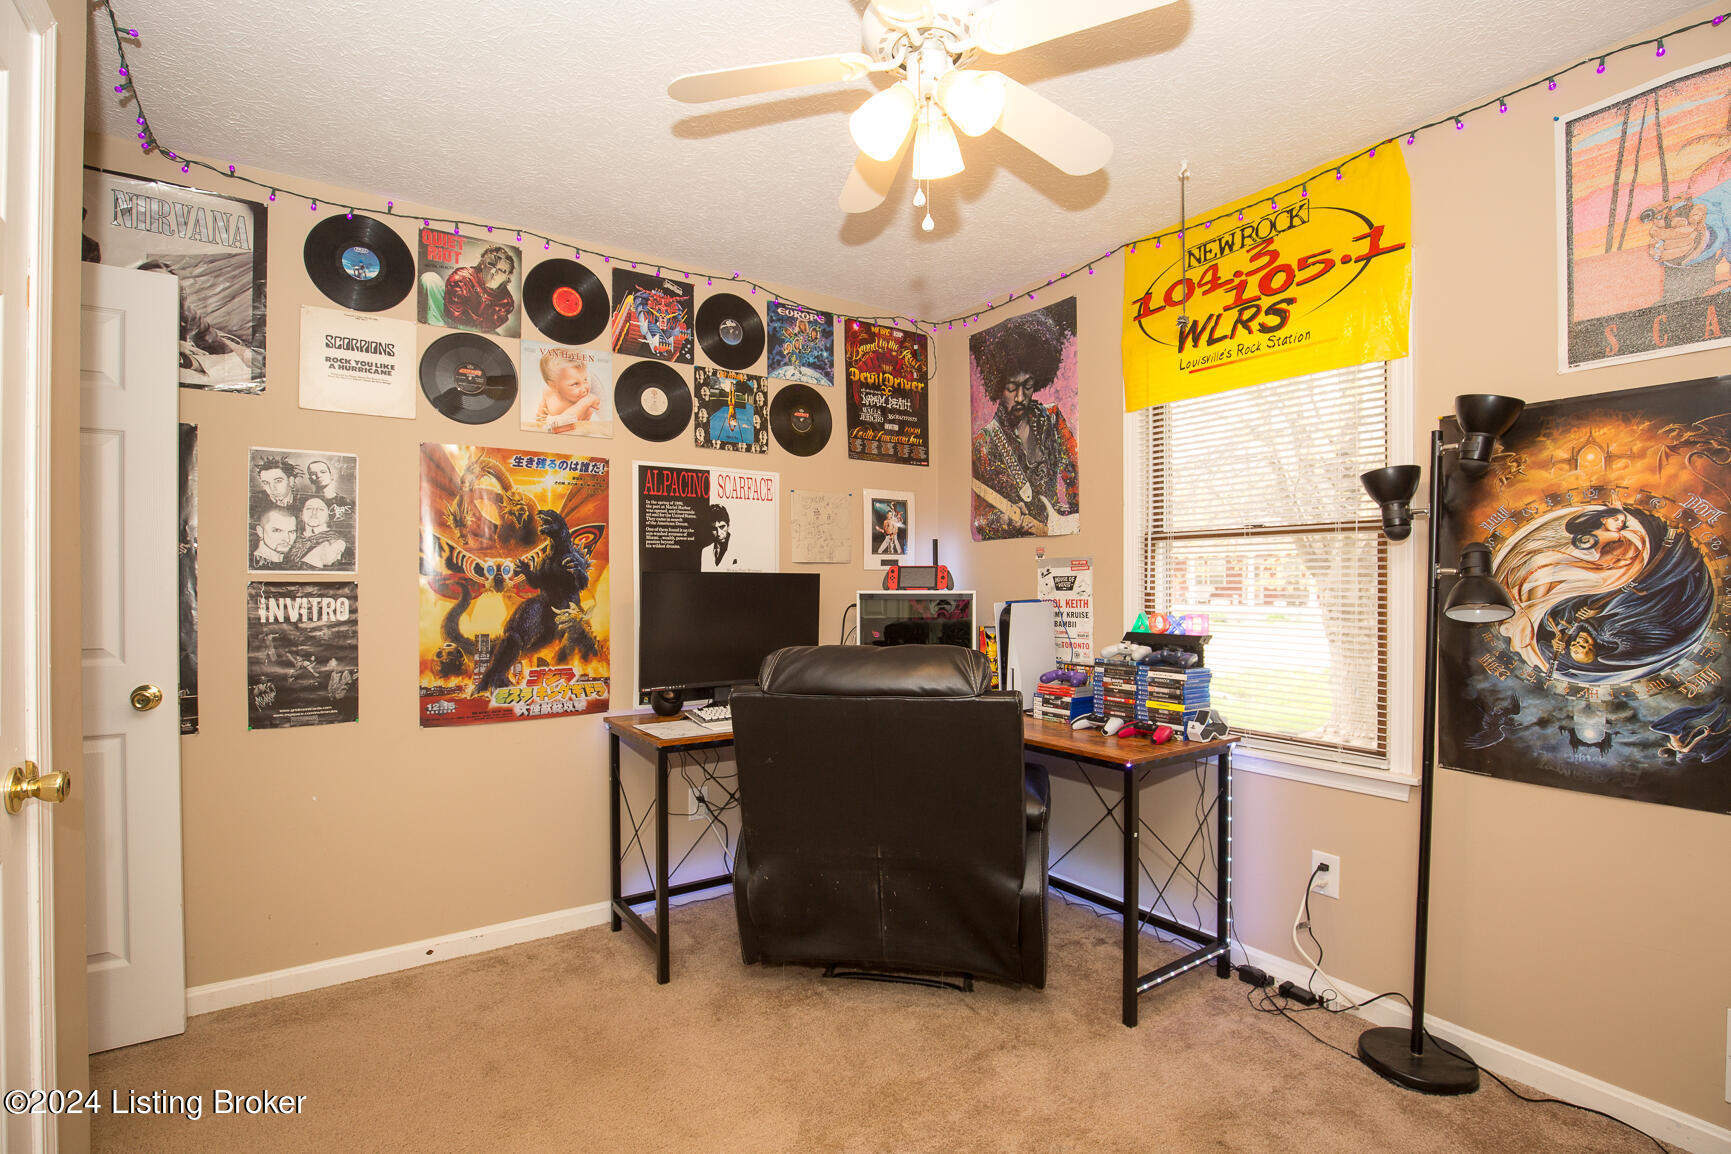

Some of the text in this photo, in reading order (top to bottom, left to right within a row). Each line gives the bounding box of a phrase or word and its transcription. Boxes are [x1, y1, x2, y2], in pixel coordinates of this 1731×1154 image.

[111, 188, 251, 251] NIRVANA
[422, 229, 465, 250] QUIET
[1187, 202, 1309, 268] NEW ROCK
[427, 246, 462, 265] RIOT
[1223, 225, 1406, 312] 105.1
[1132, 238, 1280, 322] 104.3
[778, 307, 825, 324] EUROPE
[1177, 297, 1297, 353] WLRS
[325, 334, 395, 357] SCORPIONS
[1179, 330, 1311, 371] Louisville's Rock Station
[325, 356, 396, 371] ROCK YOU LIKE
[338, 363, 393, 377] HURRICANE
[717, 474, 773, 502] SCARFACE
[258, 597, 350, 623] INVITRO
[1065, 598, 1089, 609] KEITH
[1054, 620, 1077, 628] BAMBII
[1066, 611, 1090, 619] KRUISE
[1061, 641, 1090, 650] TORONTO
